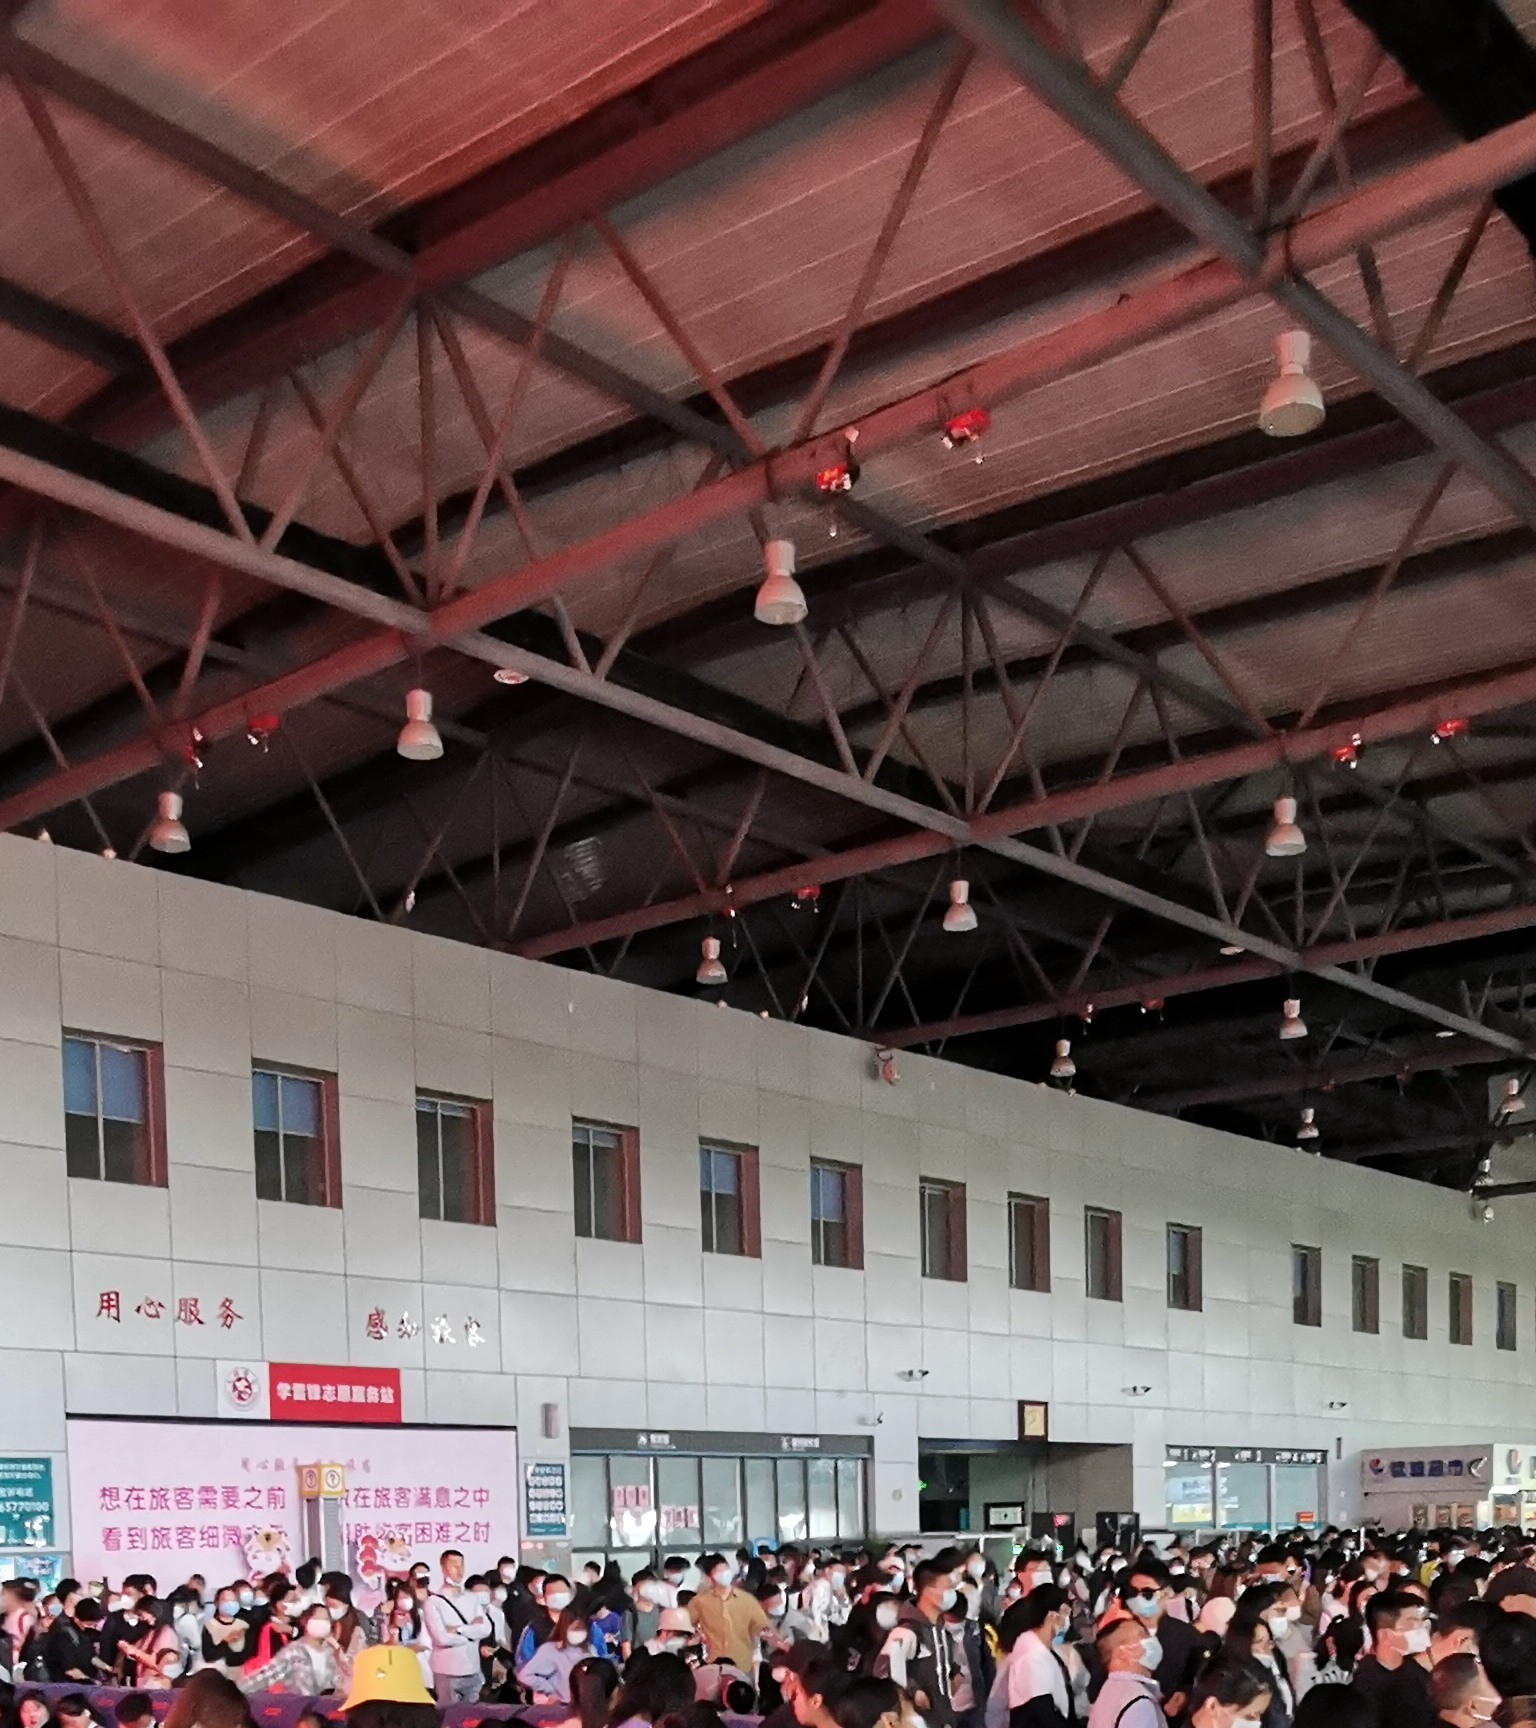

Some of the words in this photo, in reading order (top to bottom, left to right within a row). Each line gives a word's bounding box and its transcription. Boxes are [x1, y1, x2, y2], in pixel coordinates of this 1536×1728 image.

[96, 1290, 244, 1330] 用心服务
[100, 1486, 286, 1511] 想在旅客需要之前
[342, 1486, 490, 1508] 在旅客满意之中
[102, 1525, 289, 1552] 看到旅客细微
